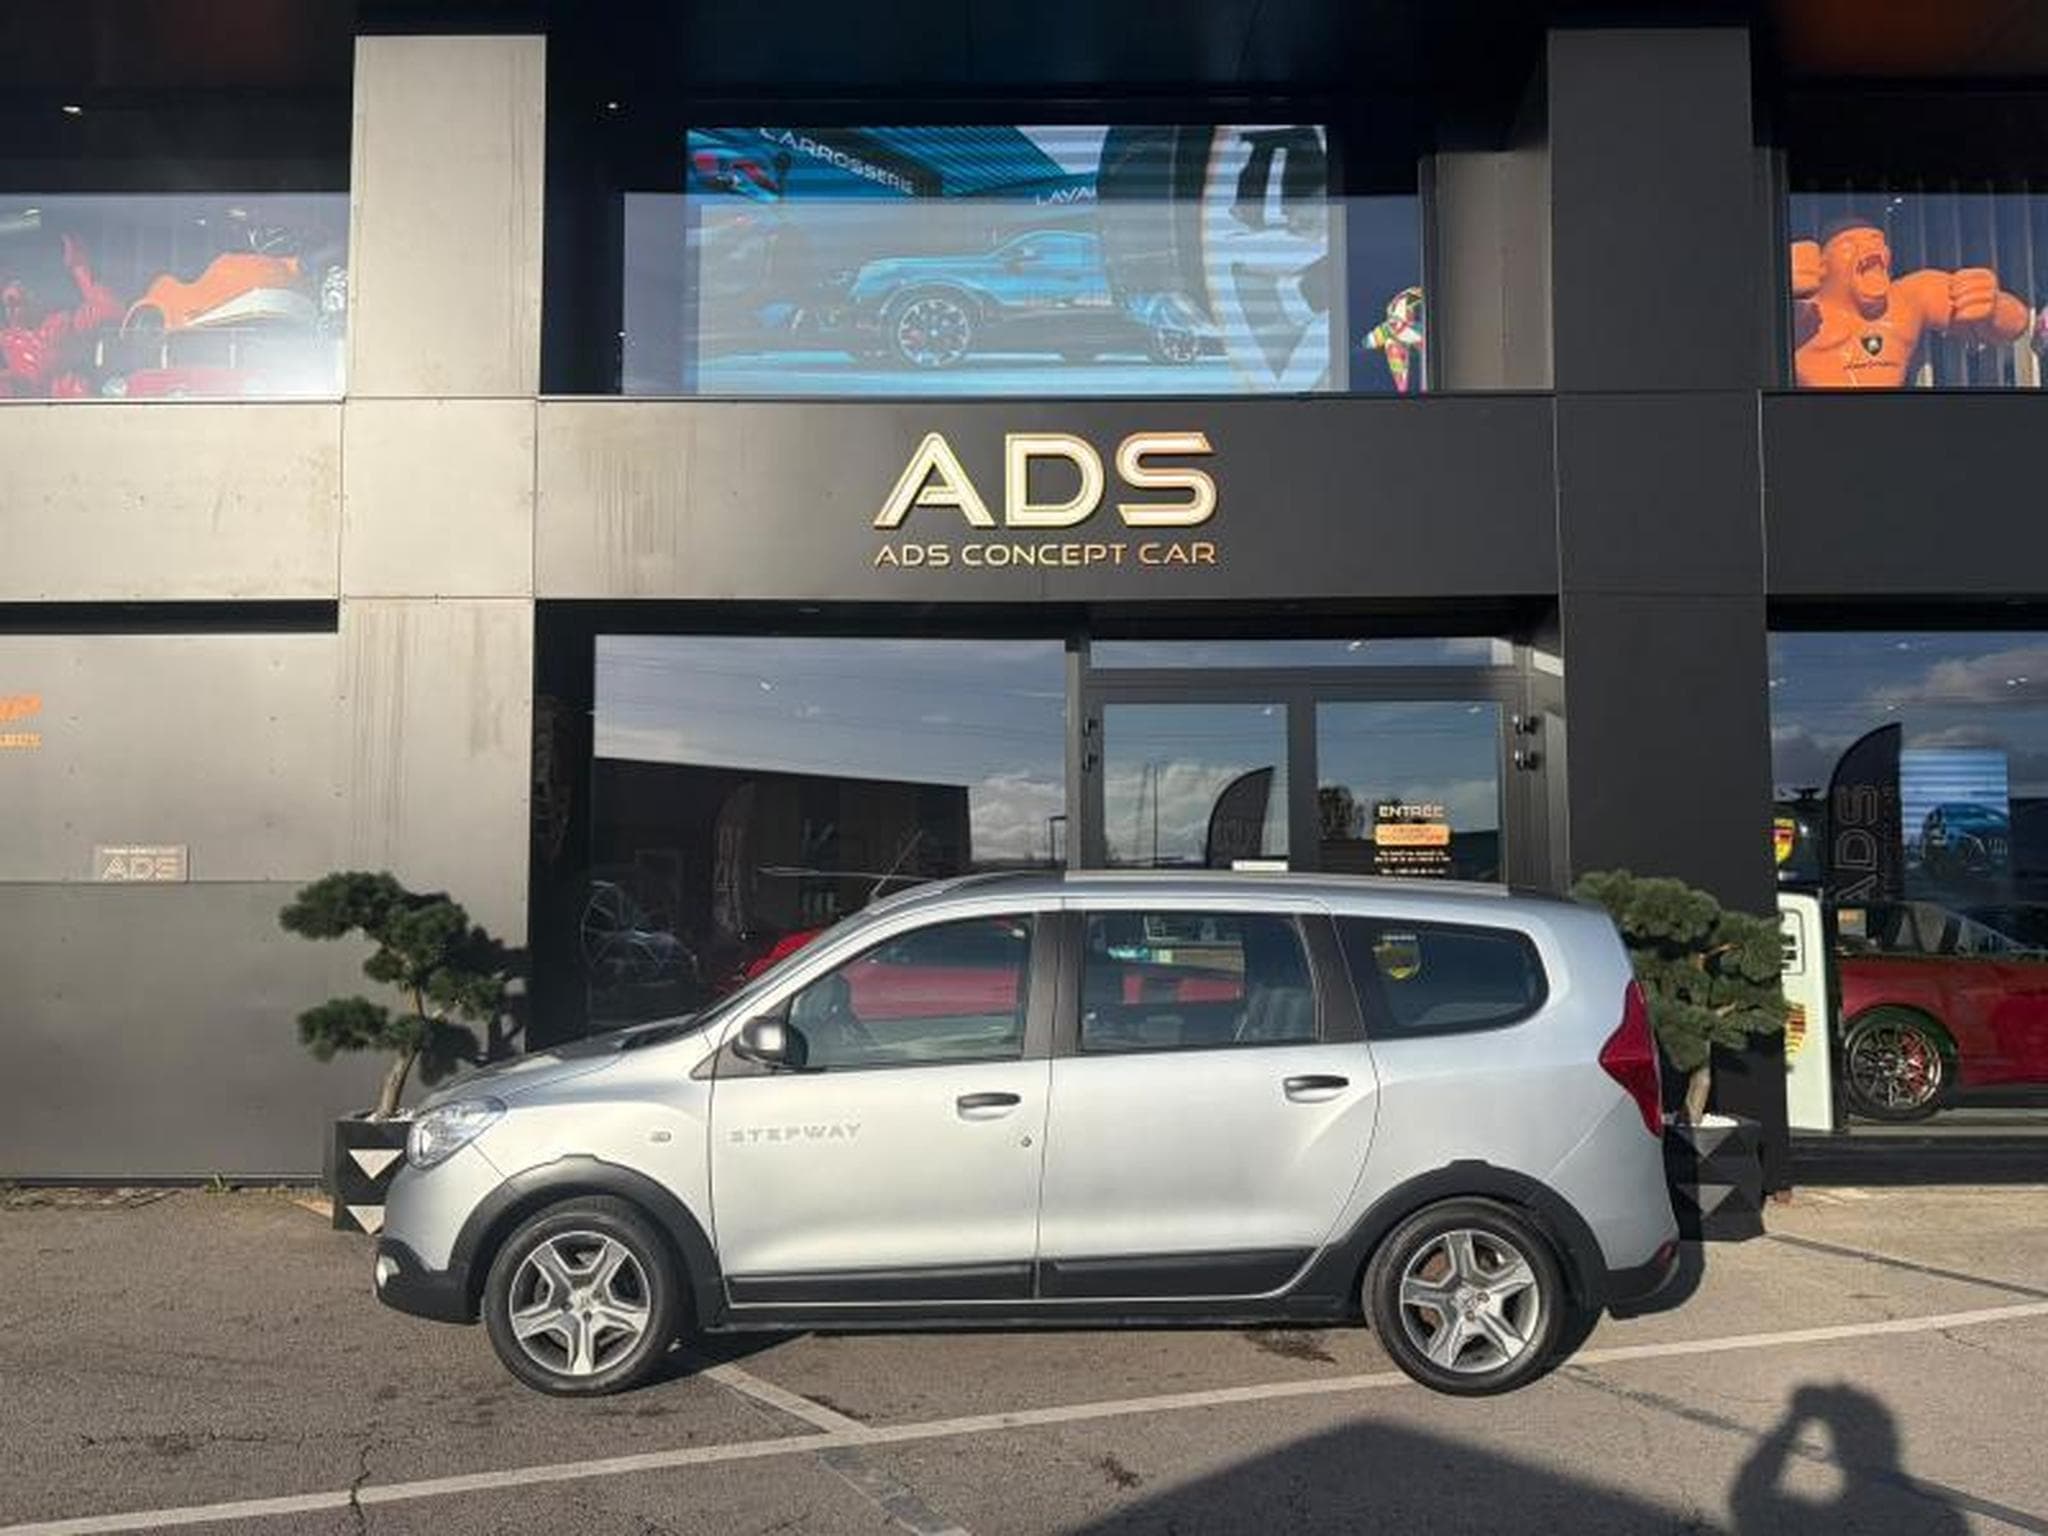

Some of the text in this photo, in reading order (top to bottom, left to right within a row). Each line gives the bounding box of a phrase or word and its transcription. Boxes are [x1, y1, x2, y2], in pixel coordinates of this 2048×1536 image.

[873, 431, 1217, 527] ADS
[874, 542, 1217, 566] ADS CONCEPT CAR
[731, 1123, 861, 1142] STEPWAY
